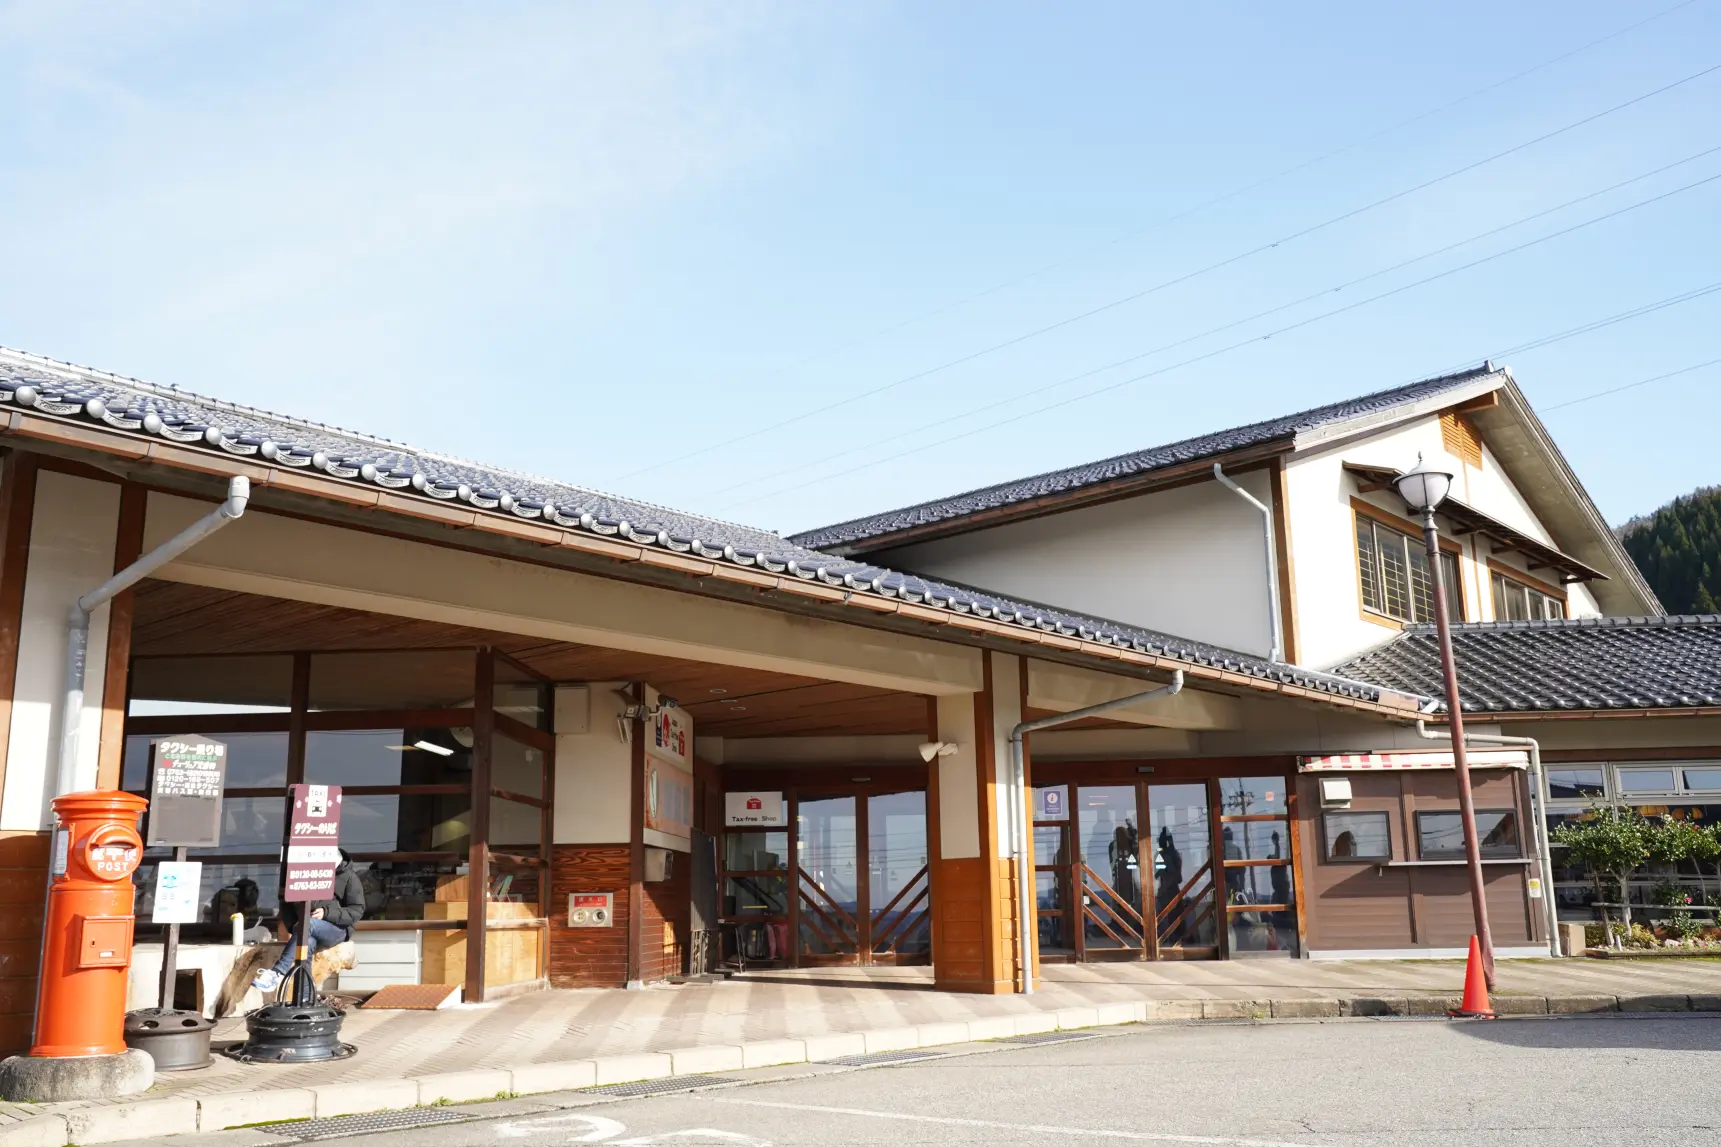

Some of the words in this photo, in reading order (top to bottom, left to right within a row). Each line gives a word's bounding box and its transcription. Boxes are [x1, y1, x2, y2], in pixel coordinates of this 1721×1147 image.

[294, 822, 337, 835] タクシーのりば
[97, 861, 129, 872] POST
